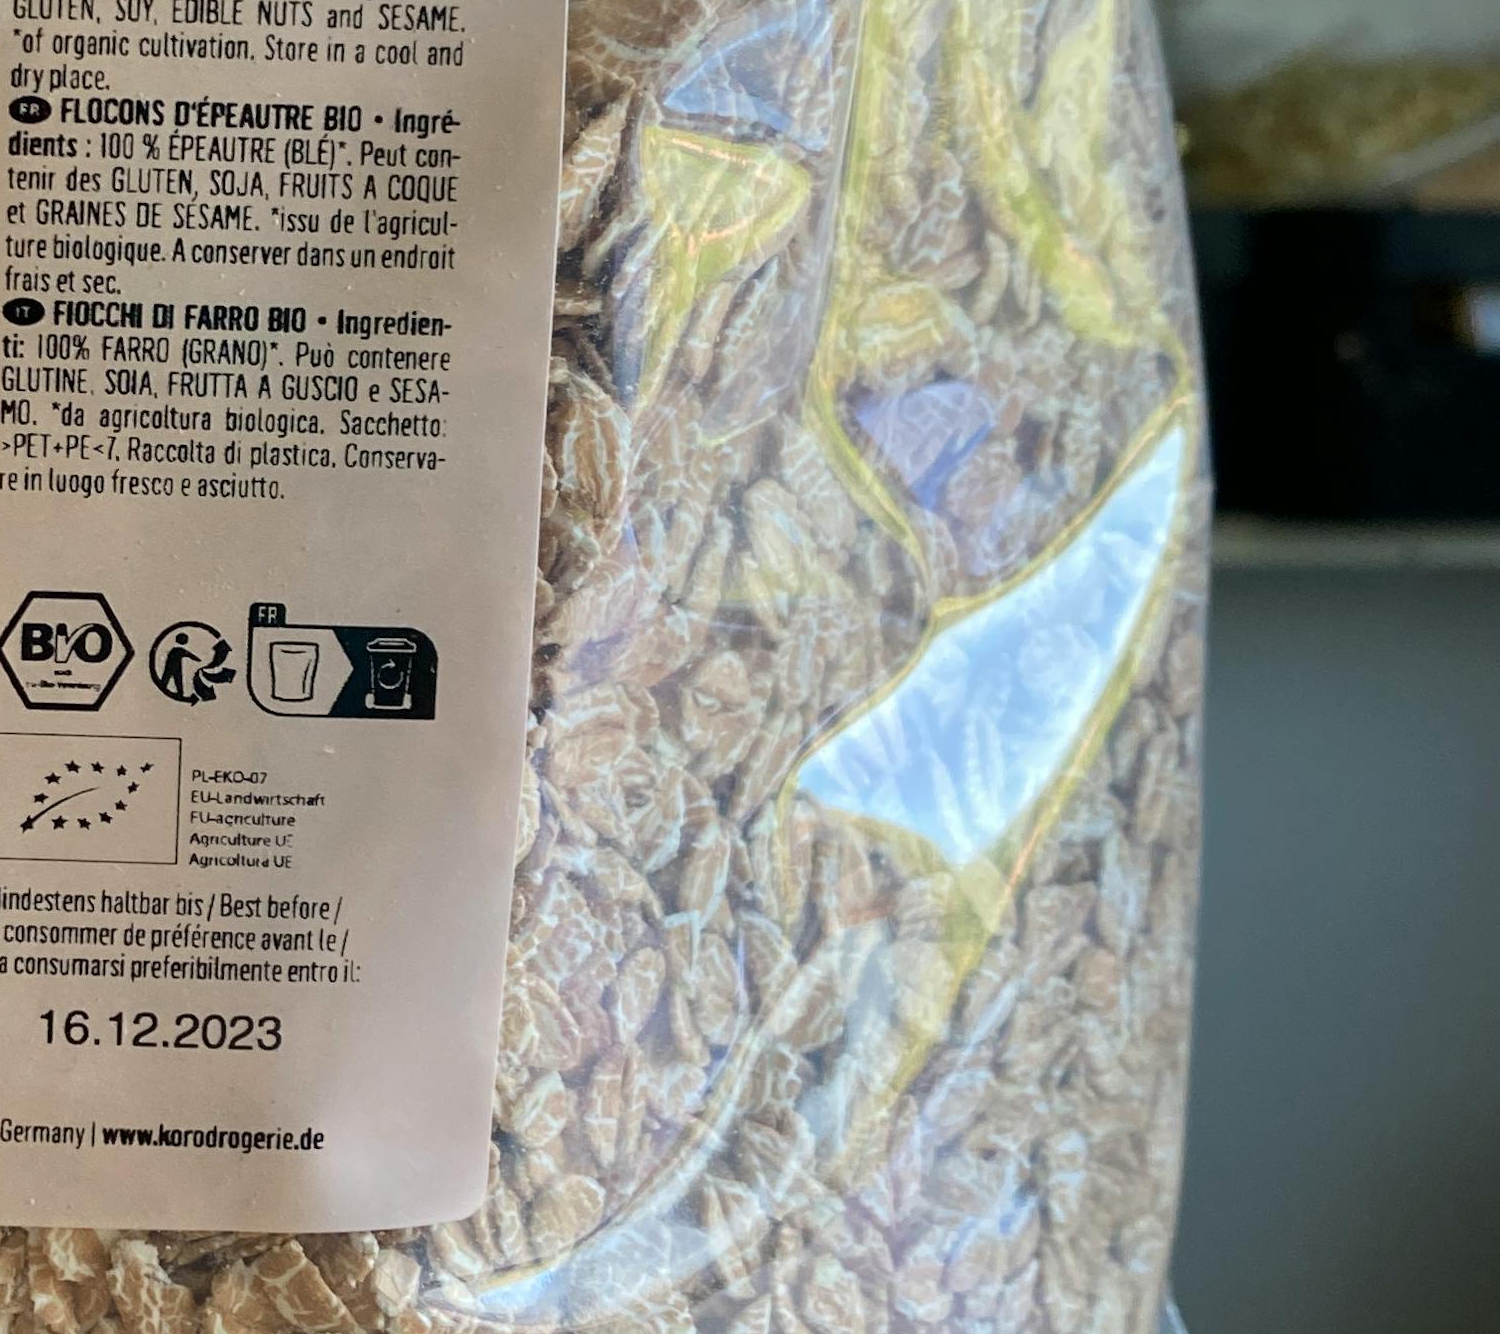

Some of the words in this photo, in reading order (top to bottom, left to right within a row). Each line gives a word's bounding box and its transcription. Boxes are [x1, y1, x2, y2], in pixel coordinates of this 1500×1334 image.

[258, 0, 312, 27] NUTS
[327, 4, 363, 29] and
[378, 4, 465, 32] SESAME.
[52, 30, 129, 60] organic
[139, 32, 254, 60] cultivation.
[265, 34, 318, 62] Store
[327, 37, 345, 62] in
[355, 44, 365, 64] a
[375, 41, 417, 64] cool
[428, 41, 463, 66] and
[19, 103, 41, 119] FR
[61, 97, 165, 126] FLOCONS
[324, 105, 362, 132] BIO
[394, 107, 461, 139] Ingré-
[7, 165, 56, 190] tenir
[66, 166, 101, 192] des
[112, 166, 198, 202] GLUTEN,
[280, 172, 352, 200] FRUITS
[363, 175, 376, 200] A
[388, 174, 459, 203] COQUE
[14, 306, 33, 319] IT
[53, 300, 143, 329] FIOCCHI
[152, 303, 174, 330] DI
[185, 304, 259, 332] FARRO
[268, 307, 306, 333] BIO
[337, 309, 452, 340] Ingredien-
[105, 369, 158, 399] SOIA,
[168, 371, 247, 398] FRUTTA
[258, 374, 271, 399] A
[282, 374, 358, 402] GUSCIO
[389, 377, 450, 403] SESA-
[258, 608, 277, 622] FR
[21, 622, 113, 664] BIO
[191, 790, 324, 806] EU-Landwirtschaft
[190, 833, 271, 847] Agriculture
[189, 853, 269, 868] Agricoltura
[273, 855, 292, 868] UE
[101, 889, 170, 915] haltbar
[176, 892, 203, 917] bis
[220, 893, 262, 918] Best
[268, 894, 329, 920] before
[3, 925, 118, 946] consommer
[123, 923, 146, 947] de
[151, 923, 256, 951] préférence
[261, 931, 313, 951] avant
[319, 928, 336, 952] le
[14, 953, 125, 977] consumarsi
[131, 955, 282, 982] preferibilmente
[288, 962, 337, 983] entro
[343, 959, 360, 982] il:
[40, 1009, 281, 1051] 16.12.2023
[0, 1118, 85, 1149] Germany
[102, 1123, 324, 1154] www.korodrogerie.de
